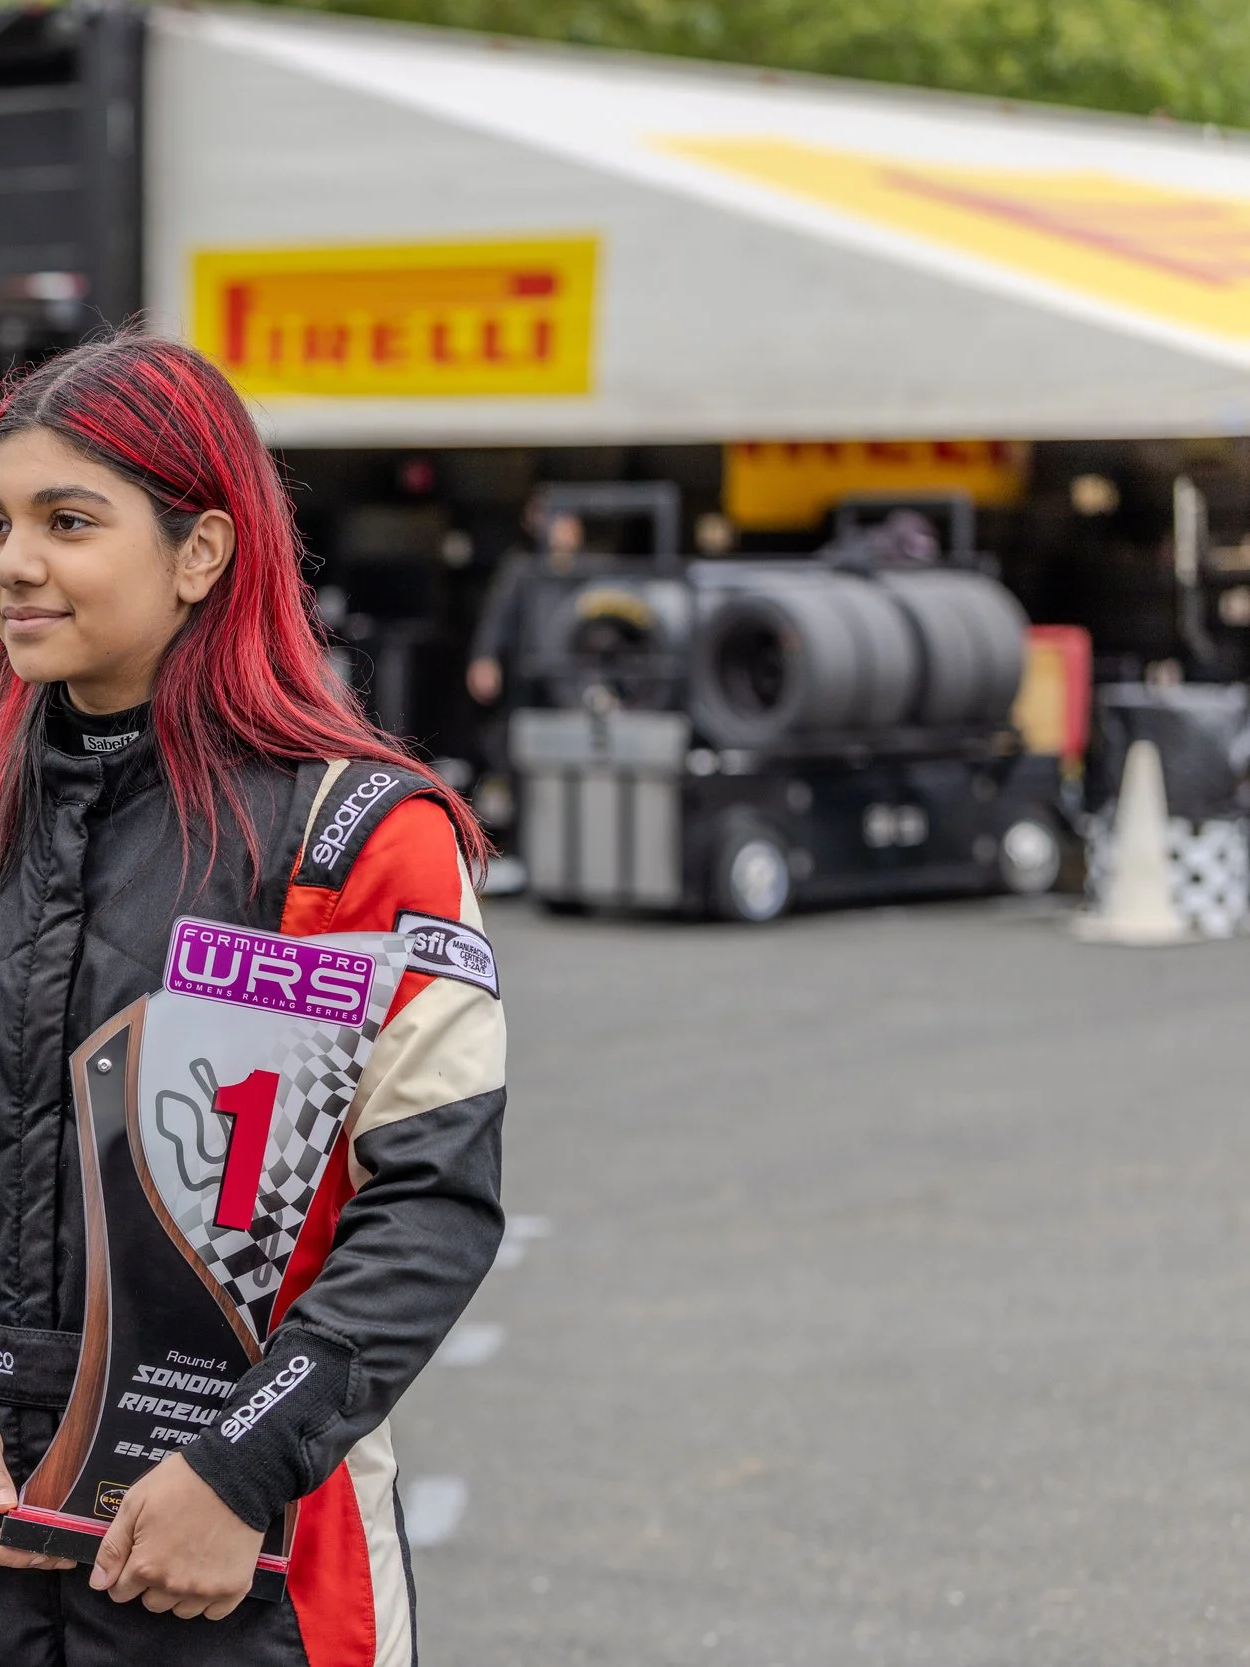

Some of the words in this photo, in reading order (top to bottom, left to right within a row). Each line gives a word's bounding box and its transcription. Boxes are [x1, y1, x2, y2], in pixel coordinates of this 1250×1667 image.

[222, 262, 562, 370] PIRELLI
[88, 735, 131, 751] Sabelt
[312, 773, 396, 867] sparco
[183, 928, 297, 960] FORMULA
[318, 953, 368, 973] PRO
[413, 931, 447, 955] sfi
[177, 941, 366, 1011] WRS
[174, 980, 233, 998] WOMENS
[242, 993, 296, 1009] RACING
[306, 1005, 358, 1021] SERIES
[211, 1069, 281, 1233] 1
[166, 1350, 215, 1369] Round
[216, 1360, 227, 1372] 4
[117, 1391, 222, 1426] RACEW
[220, 1355, 315, 1443] sparco
[150, 1426, 201, 1445] APRI
